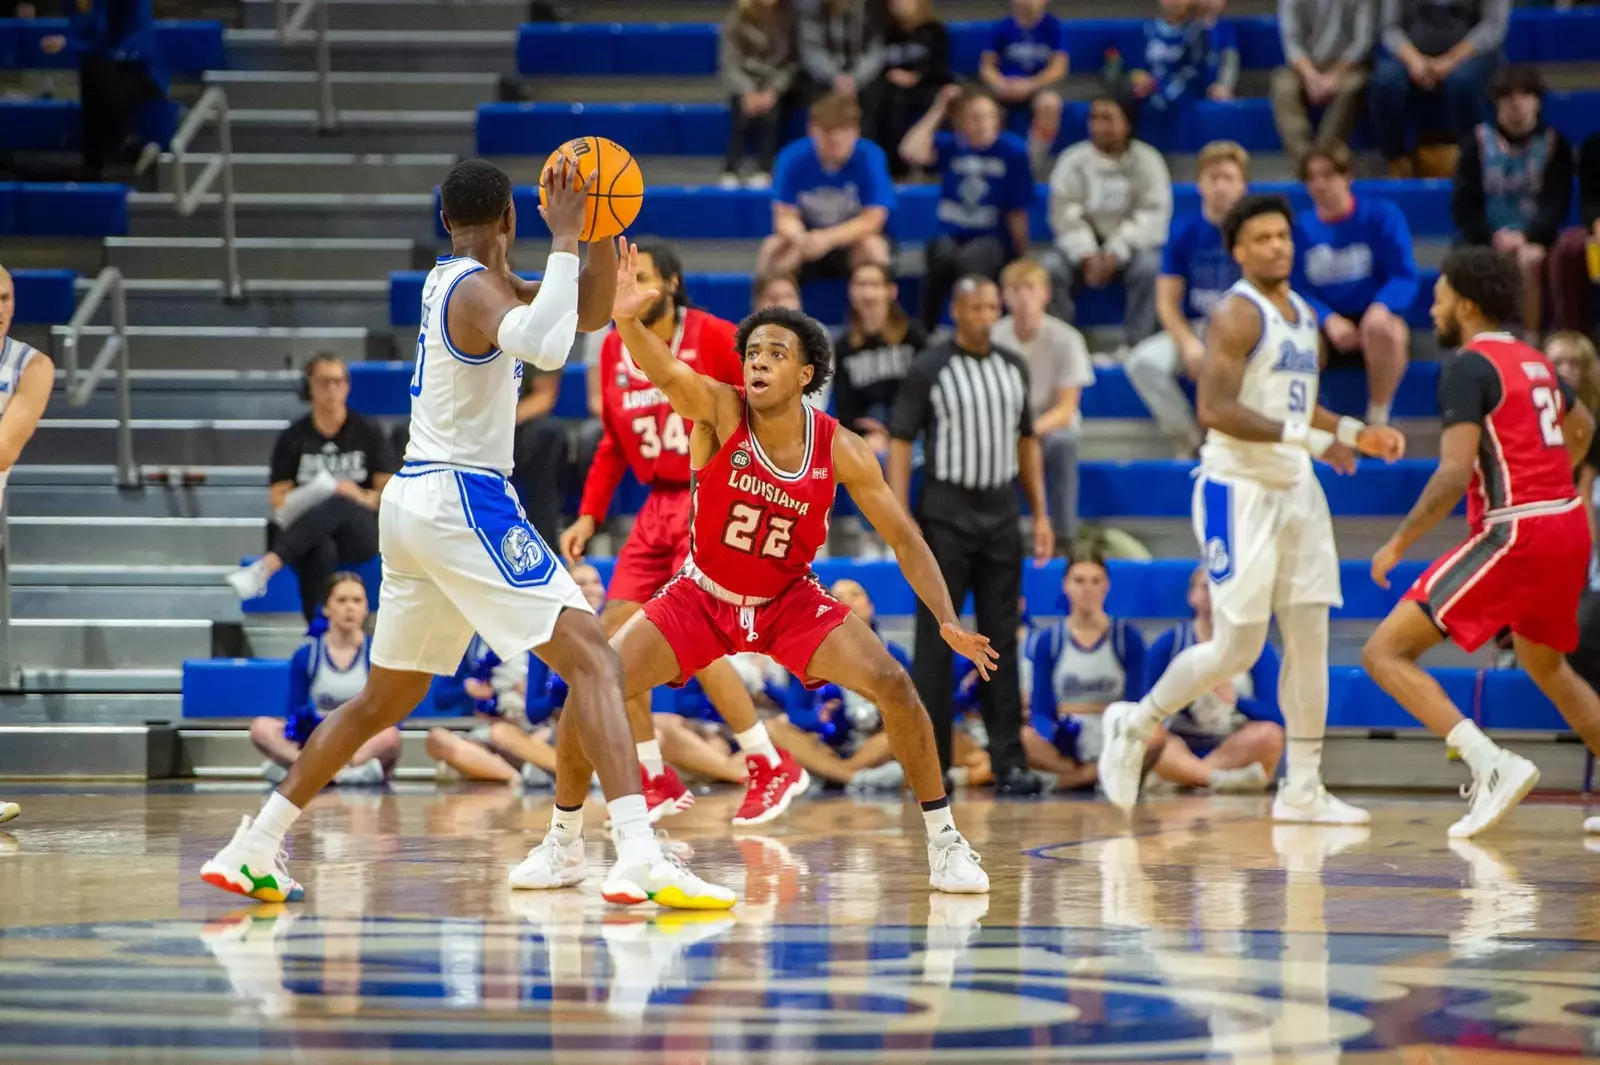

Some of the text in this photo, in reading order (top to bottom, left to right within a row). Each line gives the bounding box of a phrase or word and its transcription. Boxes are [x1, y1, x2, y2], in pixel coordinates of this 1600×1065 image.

[632, 411, 690, 459] 34
[733, 453, 748, 466] GS
[728, 470, 810, 516] LOUISIANA
[721, 500, 798, 560] 22
